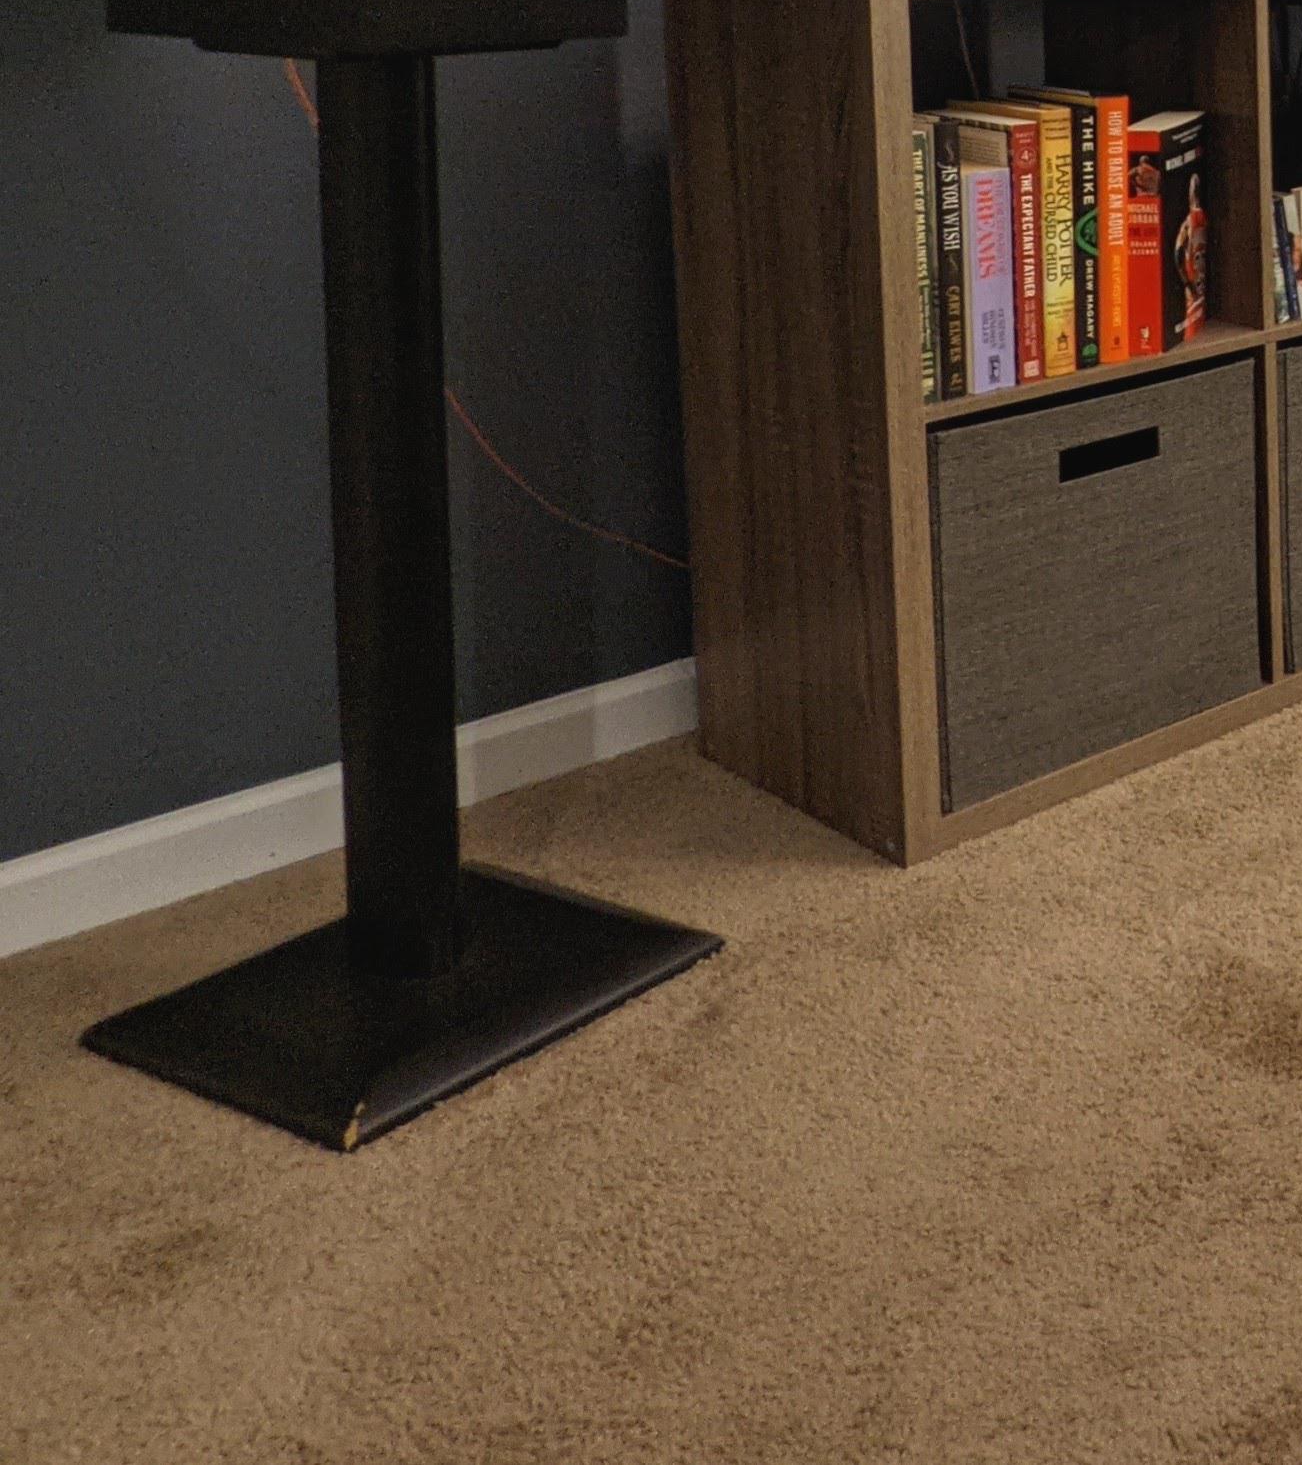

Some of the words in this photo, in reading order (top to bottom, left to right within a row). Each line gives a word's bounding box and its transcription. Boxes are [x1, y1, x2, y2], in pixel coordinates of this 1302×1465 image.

[1082, 116, 1094, 152] THE
[1108, 110, 1122, 136] HOW
[913, 150, 923, 173] THE
[1108, 138, 1122, 155] TO
[914, 174, 924, 196] ART
[937, 162, 957, 183] AS
[1020, 173, 1032, 193] THE
[1056, 153, 1072, 211] HARRY
[1083, 161, 1095, 205] HIKE
[1108, 157, 1123, 191] RAISE
[915, 197, 925, 211] OF
[942, 185, 958, 210] YOU
[1108, 193, 1123, 210] AN
[1128, 203, 1159, 214] MICHAEL
[943, 212, 960, 251] WISH
[976, 178, 996, 280] DREAMS
[1021, 194, 1034, 255] EXPECTANT
[1044, 191, 1057, 241] CURSED
[1108, 211, 1123, 246] ADULT
[1128, 214, 1160, 224] JORDAN
[916, 214, 929, 278] MANLINESS
[1046, 243, 1058, 282] CHILD
[1057, 217, 1073, 287] POTTER
[1023, 257, 1036, 298] FATHER
[1085, 259, 1093, 292] DREW
[1086, 294, 1095, 339] MAGARY
